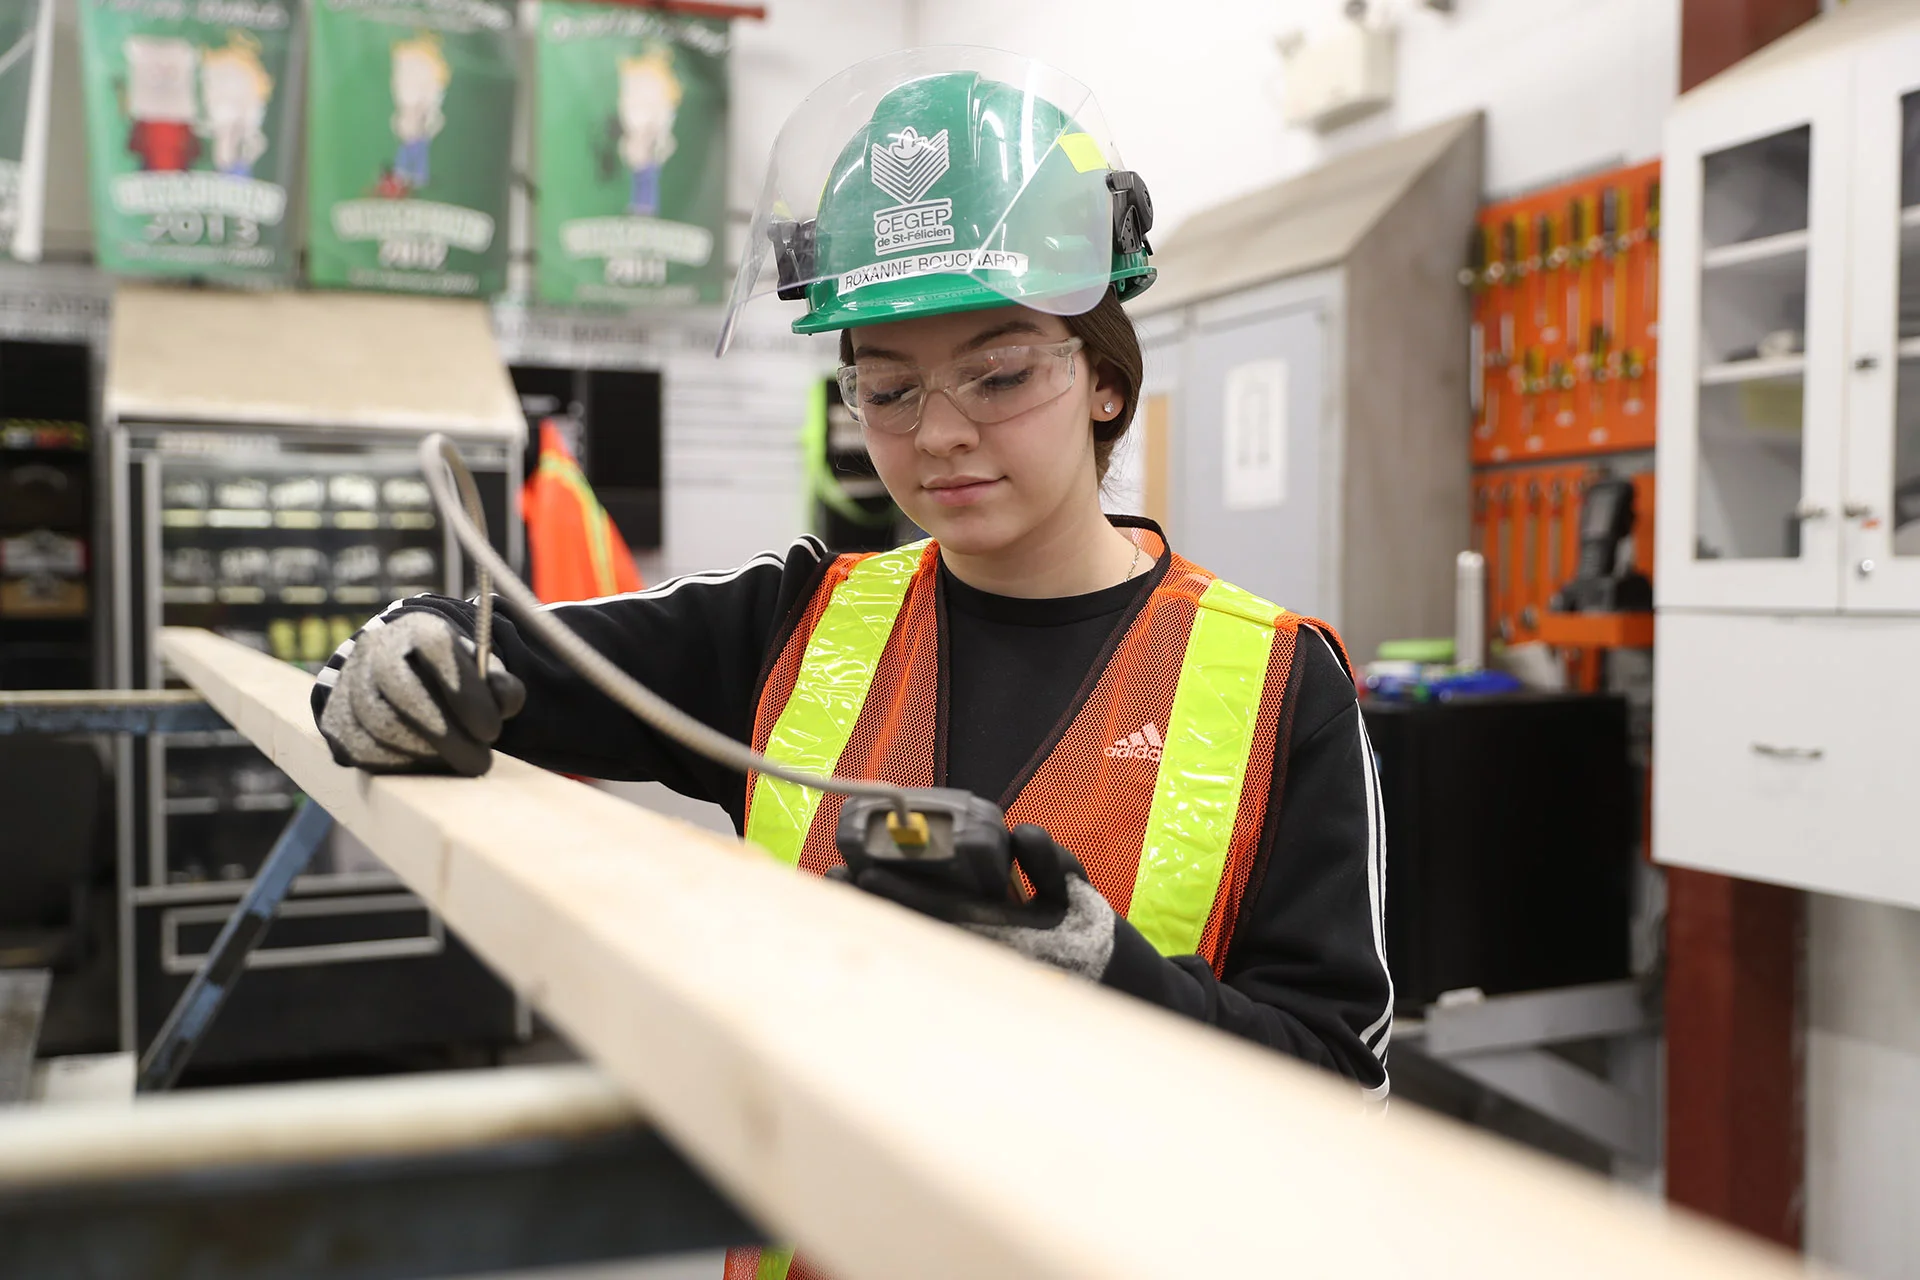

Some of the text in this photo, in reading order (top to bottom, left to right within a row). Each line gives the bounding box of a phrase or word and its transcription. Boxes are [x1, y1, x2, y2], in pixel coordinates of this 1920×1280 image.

[142, 211, 260, 246] 2013
[877, 209, 949, 235] CEGEP
[877, 227, 951, 248] de St-Félicien
[845, 252, 1018, 289] ROXANNE BOUCHARD
[1103, 743, 1161, 762] adida
